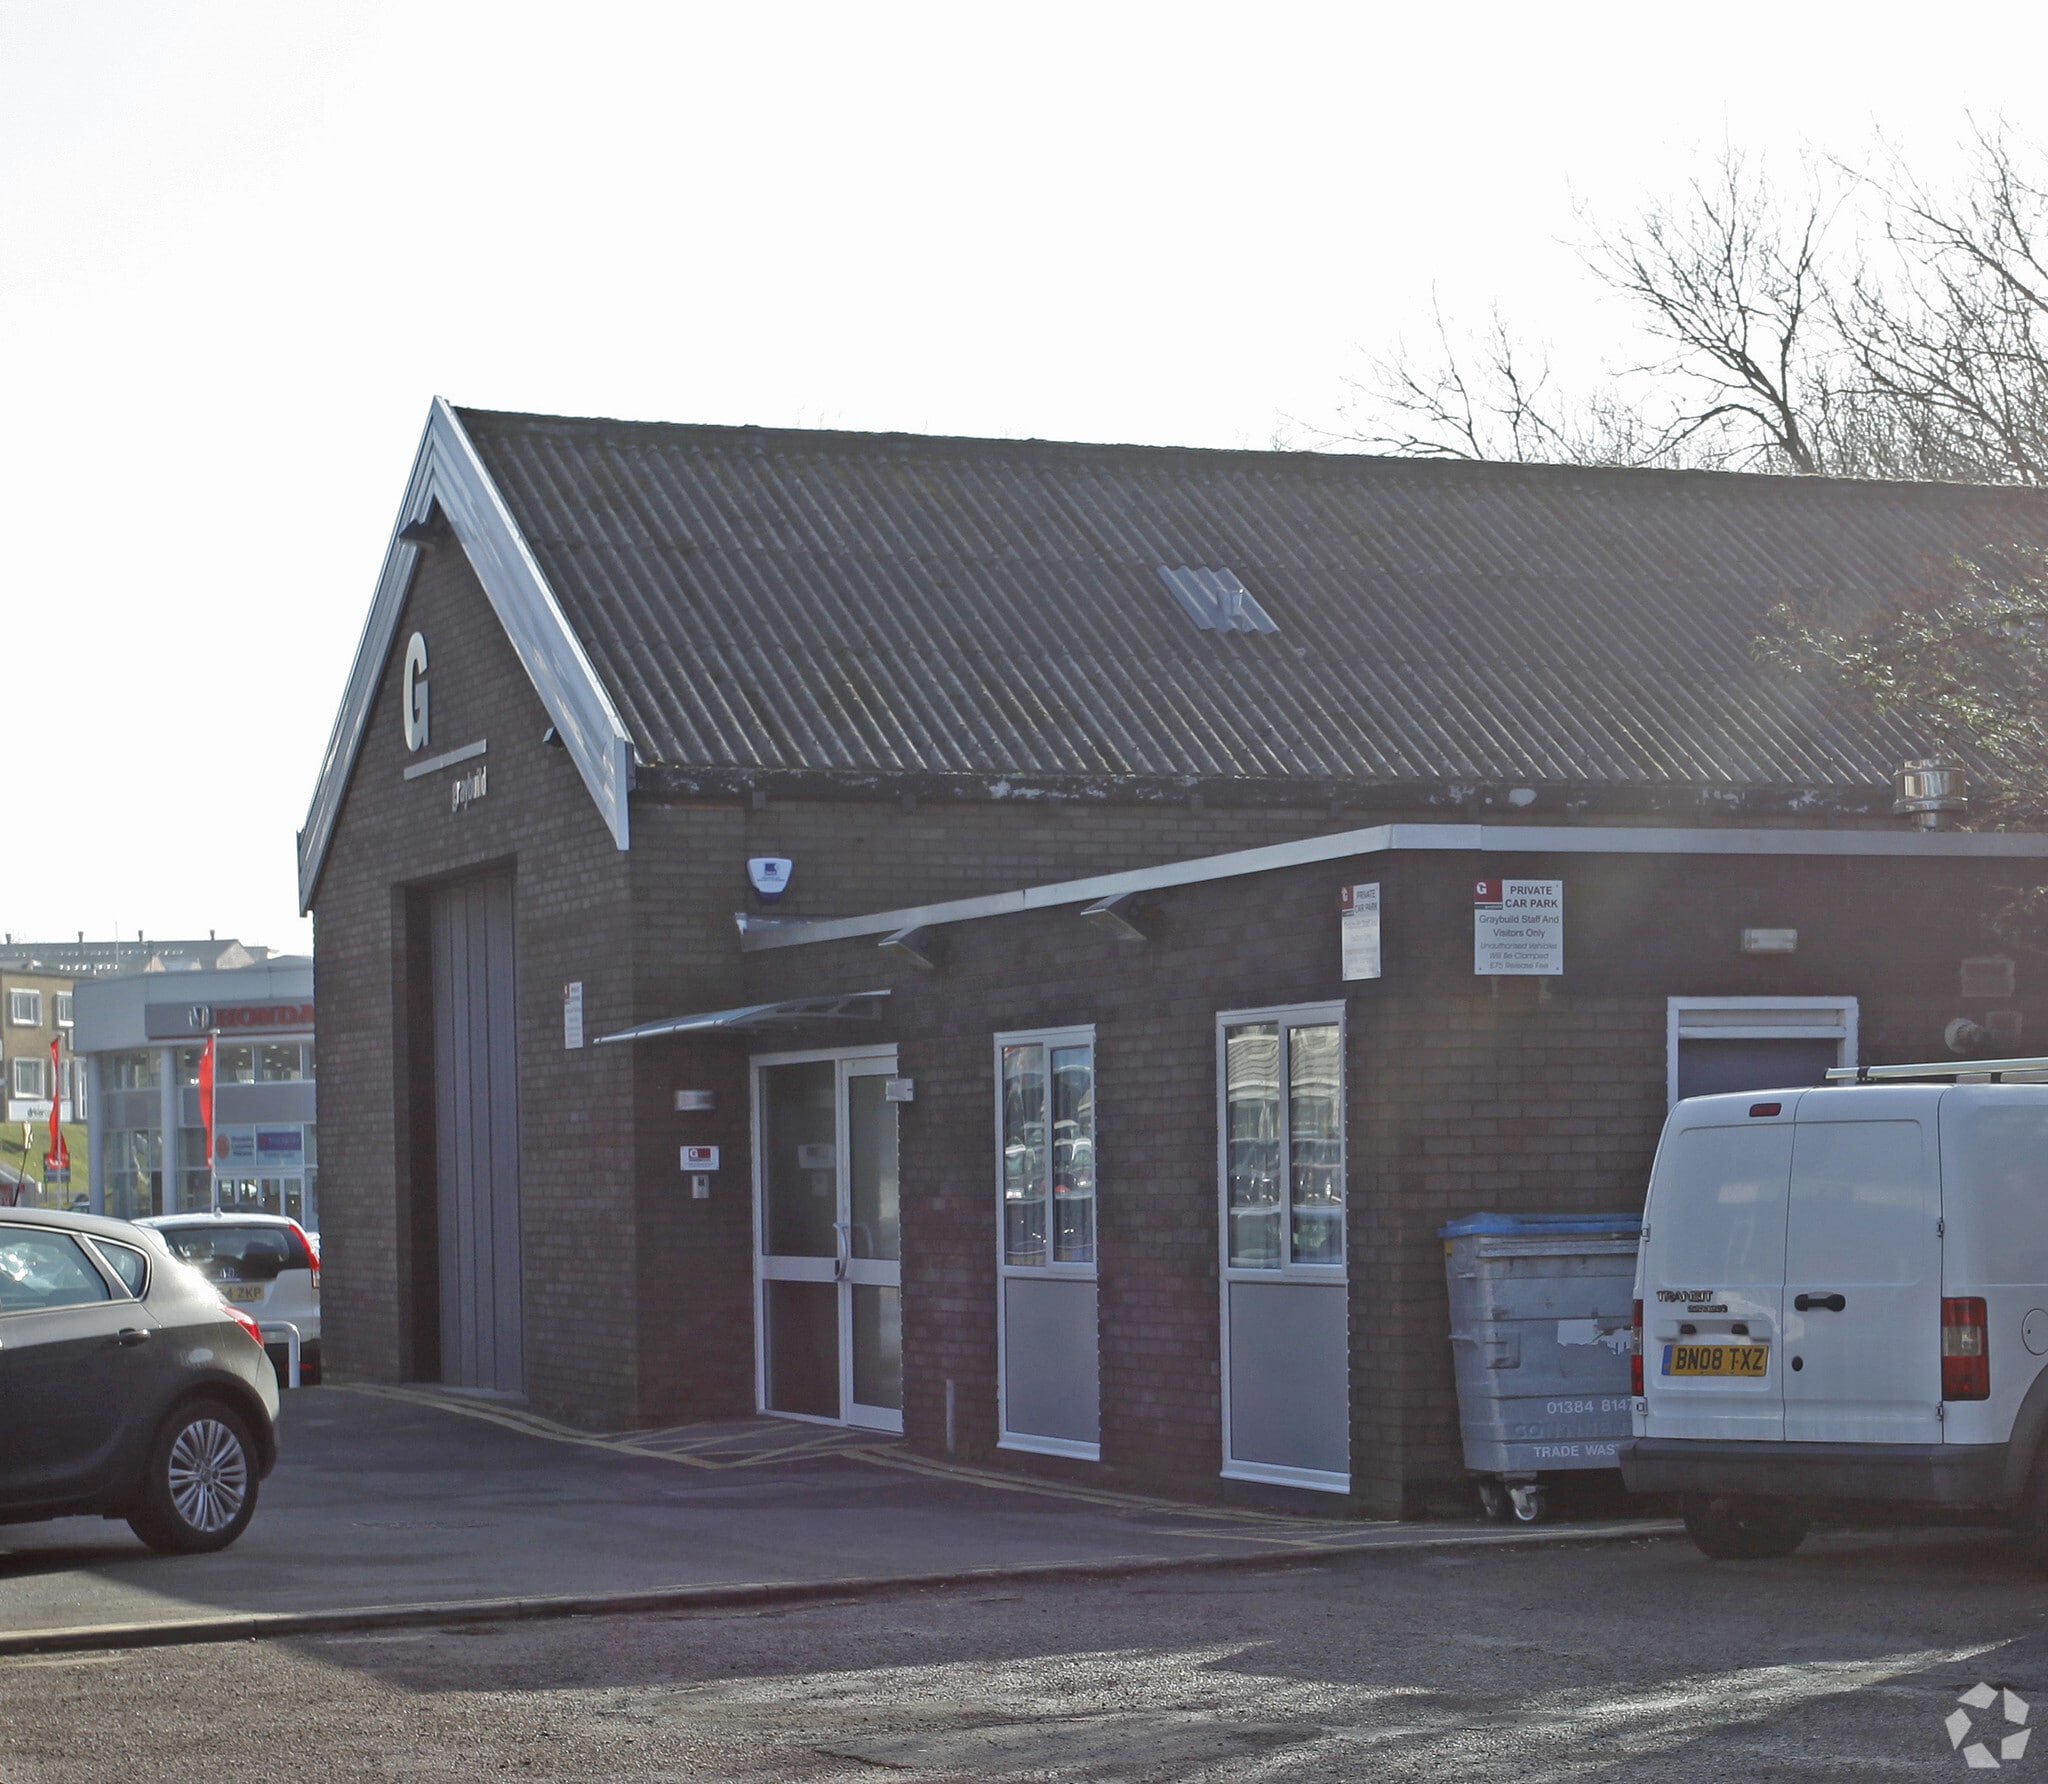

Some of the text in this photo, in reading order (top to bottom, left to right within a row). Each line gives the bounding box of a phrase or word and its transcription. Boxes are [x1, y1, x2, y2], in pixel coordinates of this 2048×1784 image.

[403, 631, 429, 751] G
[1476, 882, 1488, 894] G
[1510, 886, 1553, 895] PRIVATE
[1505, 899, 1527, 908] CAR
[1530, 899, 1558, 908] PARK
[1479, 915, 1559, 925] Graybuild Staff And
[1493, 928, 1546, 939] Visitors Only
[215, 1004, 314, 1028] HONDA
[238, 1286, 262, 1299] ZKP
[1656, 1290, 1713, 1302] TRANSIT
[1675, 1347, 1765, 1371] BN08 TXZ
[1546, 1401, 1594, 1414] 01384
[1533, 1446, 1579, 1458] TRADE
